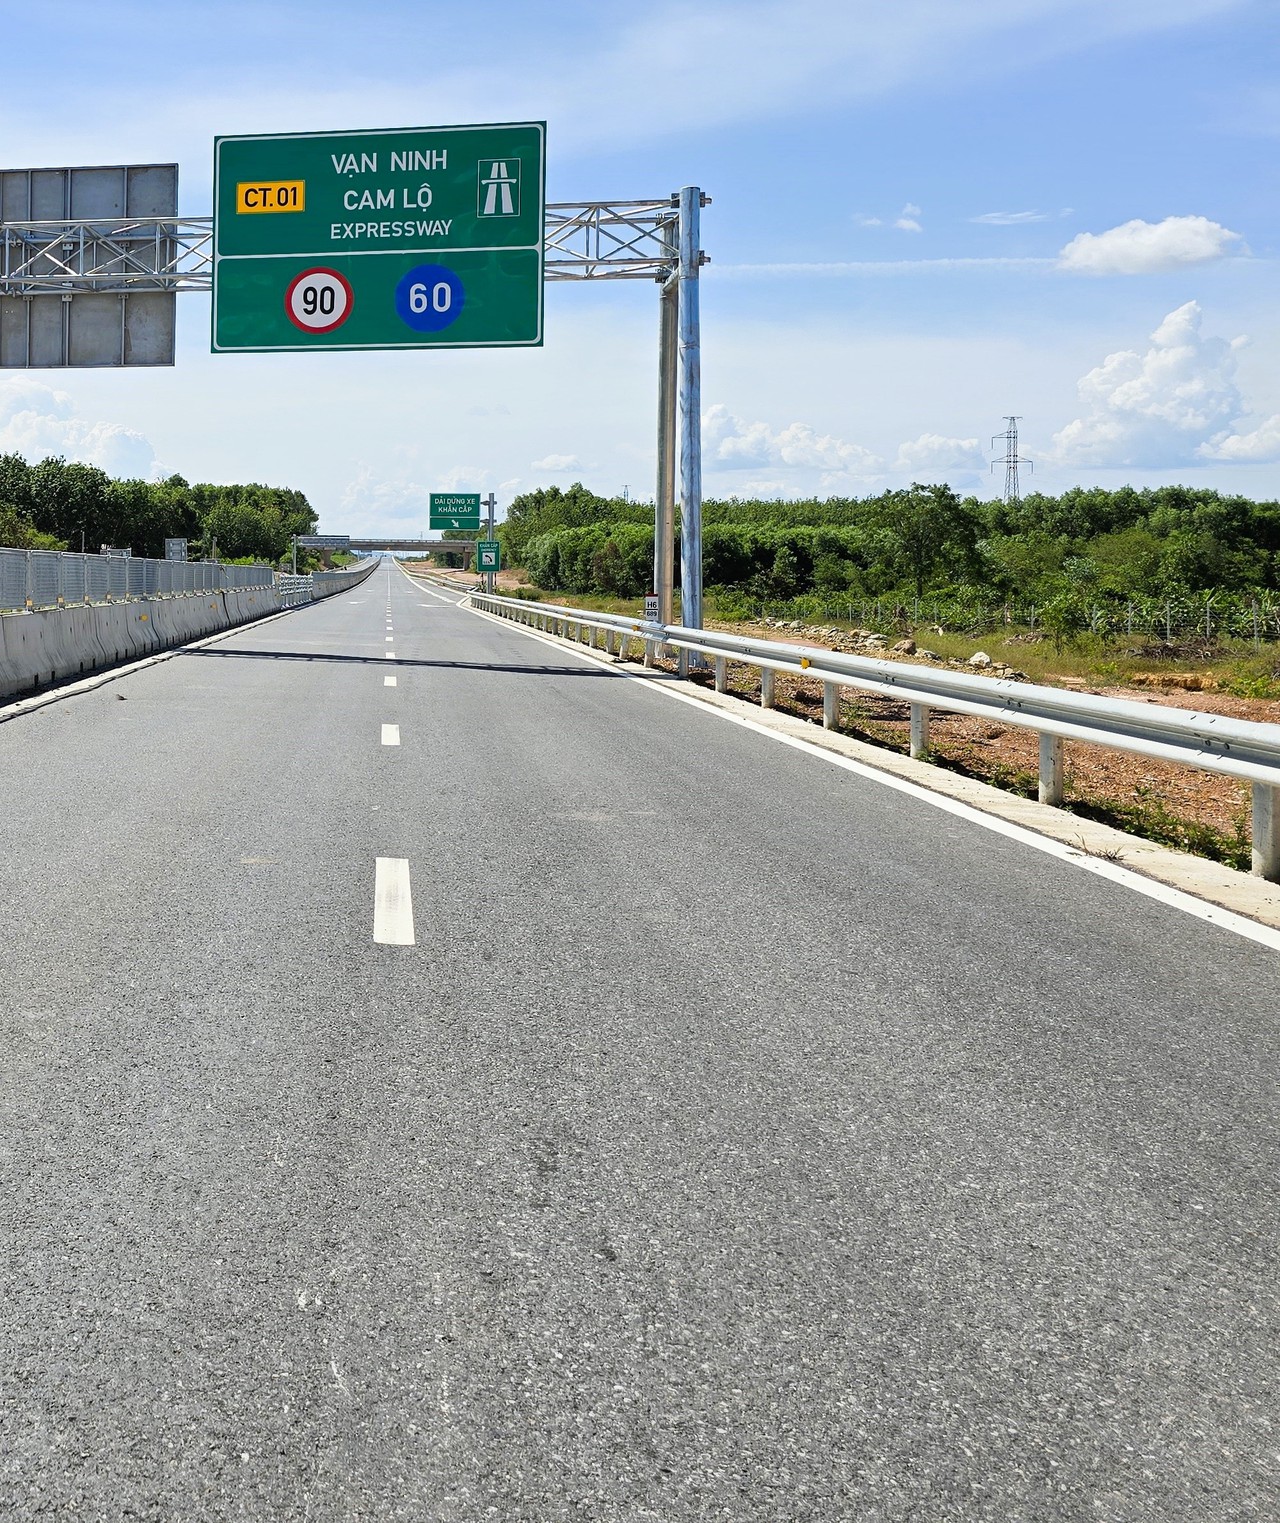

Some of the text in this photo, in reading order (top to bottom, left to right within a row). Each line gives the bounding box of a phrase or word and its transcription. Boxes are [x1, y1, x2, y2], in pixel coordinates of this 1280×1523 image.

[332, 149, 448, 178] VẠN NINH
[244, 186, 298, 208] CT.01
[343, 183, 433, 212] CAM LỘ
[330, 218, 453, 240] EXPRESSWAY
[302, 285, 336, 316] 90
[409, 282, 452, 313] 60
